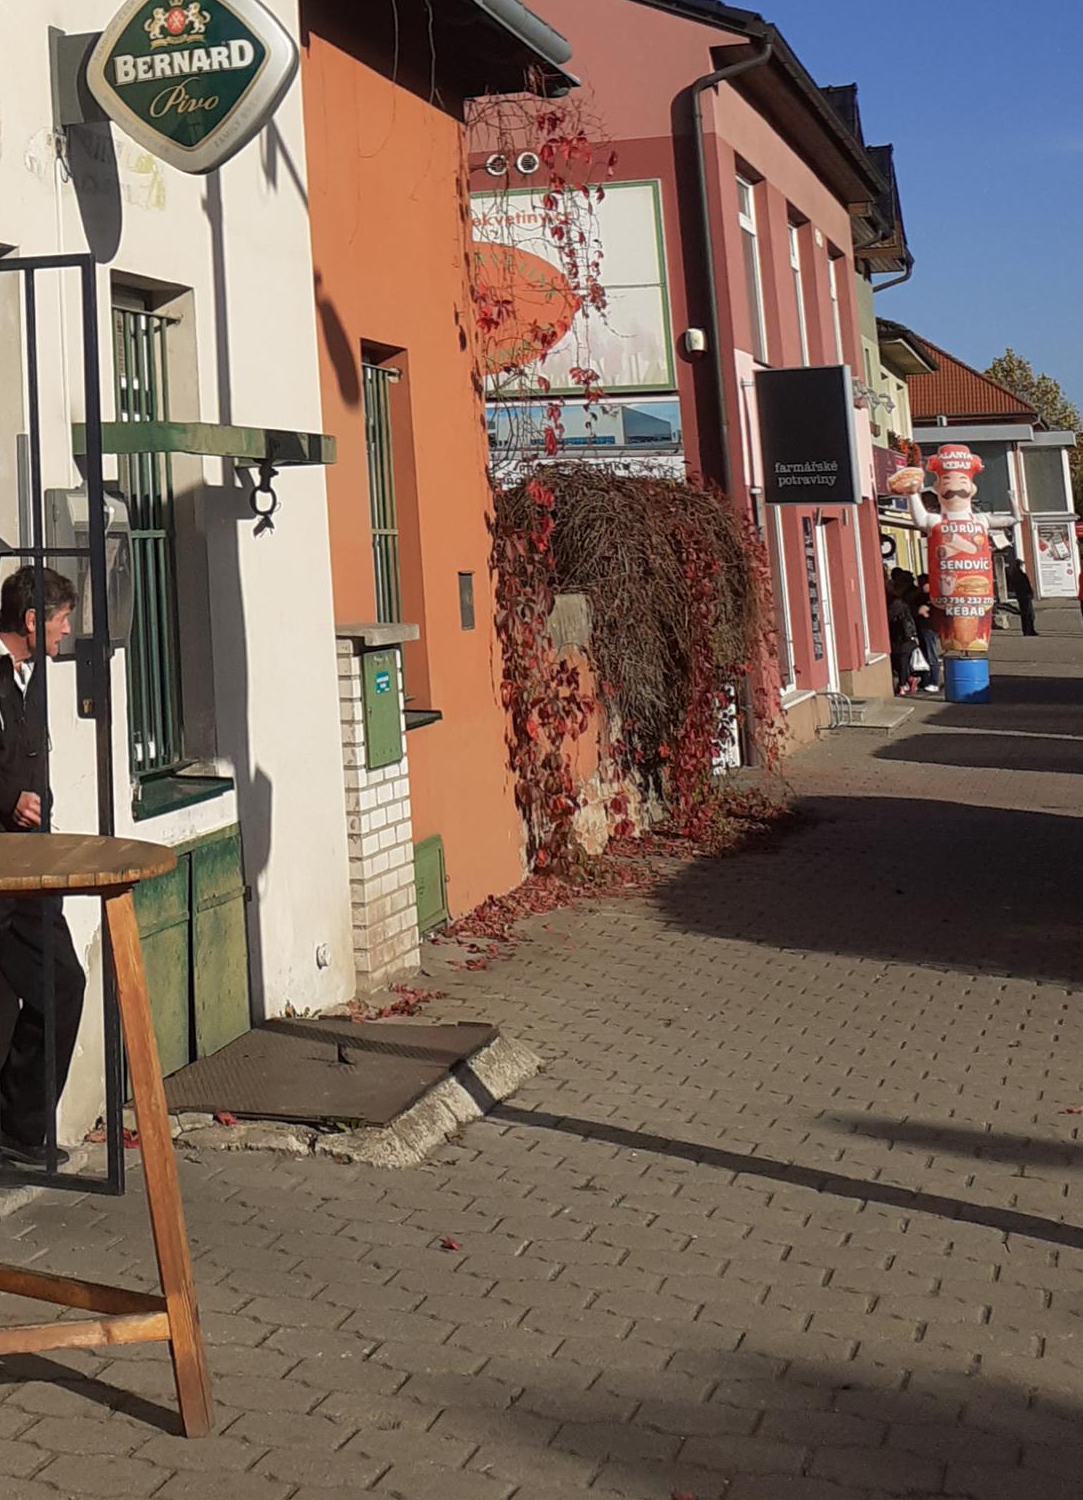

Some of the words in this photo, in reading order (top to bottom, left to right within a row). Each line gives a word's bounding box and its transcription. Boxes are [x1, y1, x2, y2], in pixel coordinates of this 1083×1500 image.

[114, 38, 255, 86] BERNARD
[149, 76, 220, 118] Pivo
[775, 461, 838, 473] farmářské
[778, 475, 837, 488] potraviny
[946, 606, 986, 617] KEBAB
